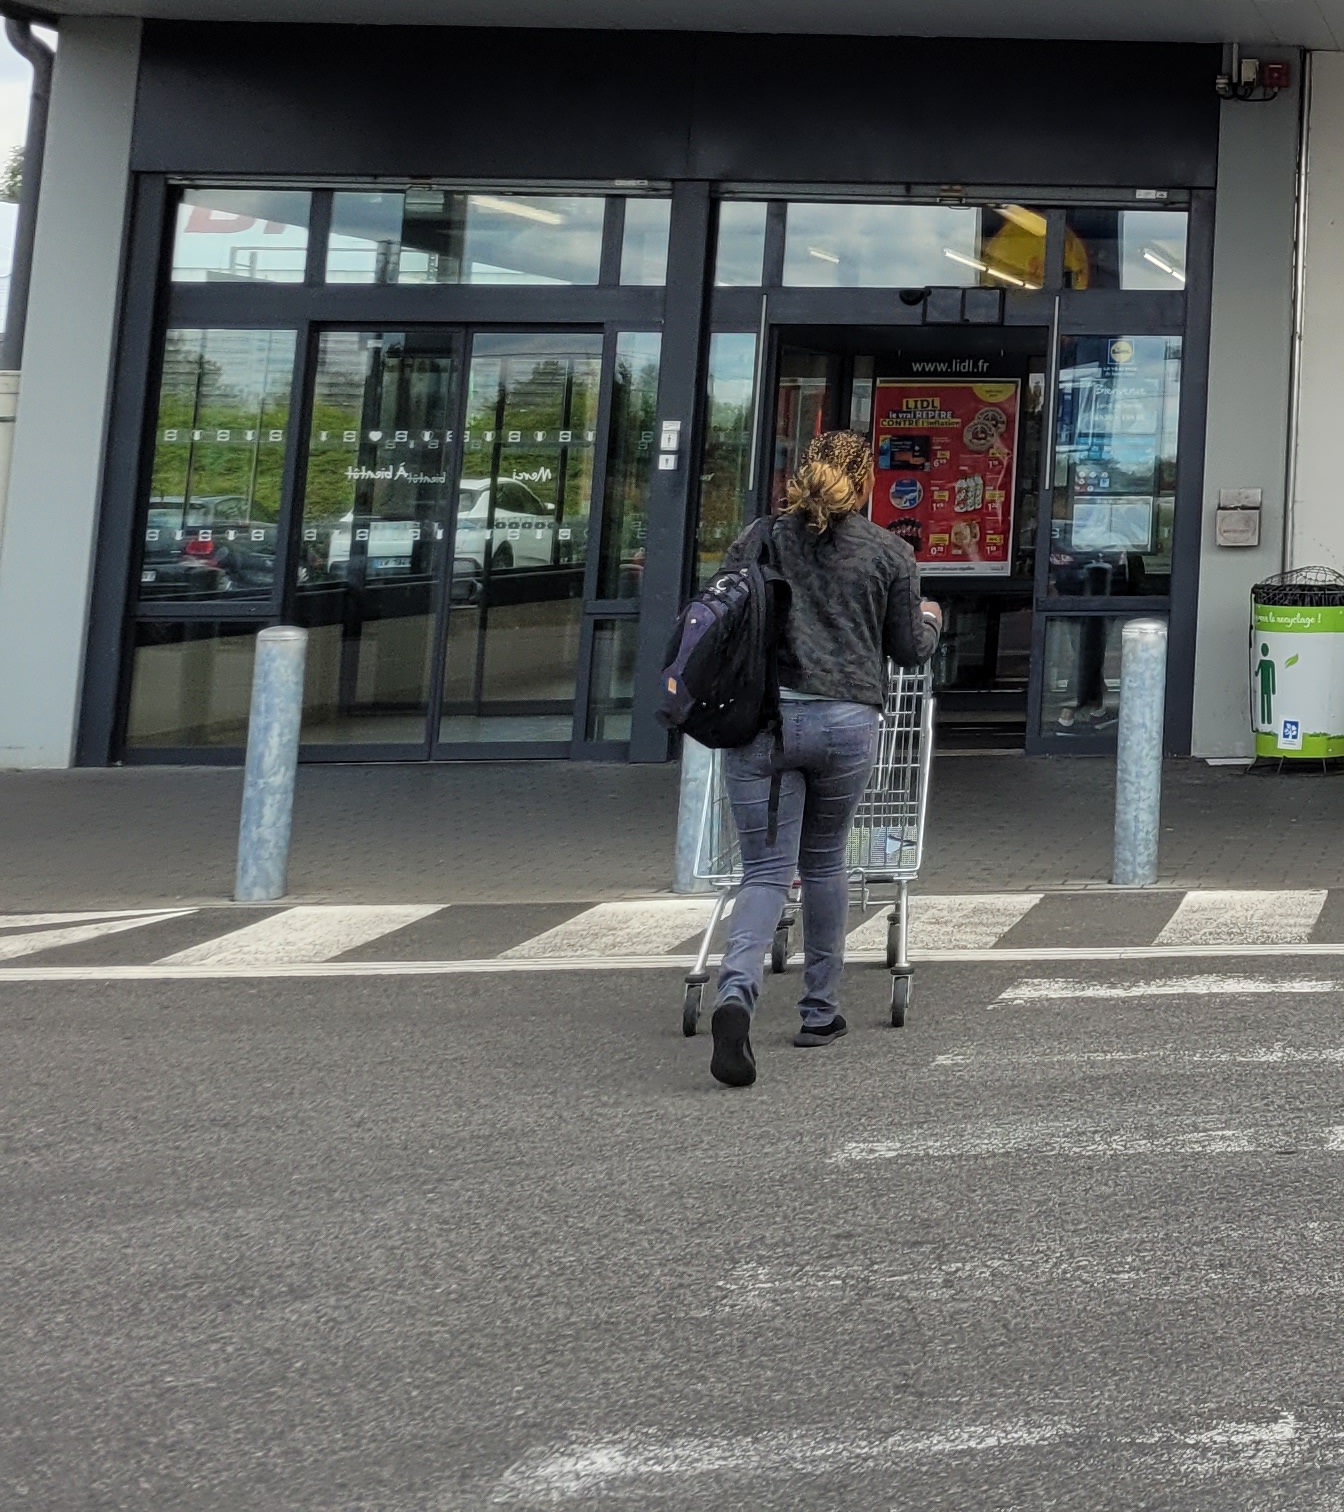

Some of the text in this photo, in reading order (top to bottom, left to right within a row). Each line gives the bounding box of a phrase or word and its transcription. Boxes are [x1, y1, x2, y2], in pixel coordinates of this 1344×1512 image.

[911, 358, 990, 372] www.lidl.fr
[905, 399, 938, 410] LIDL
[880, 419, 918, 427] CONTRE
